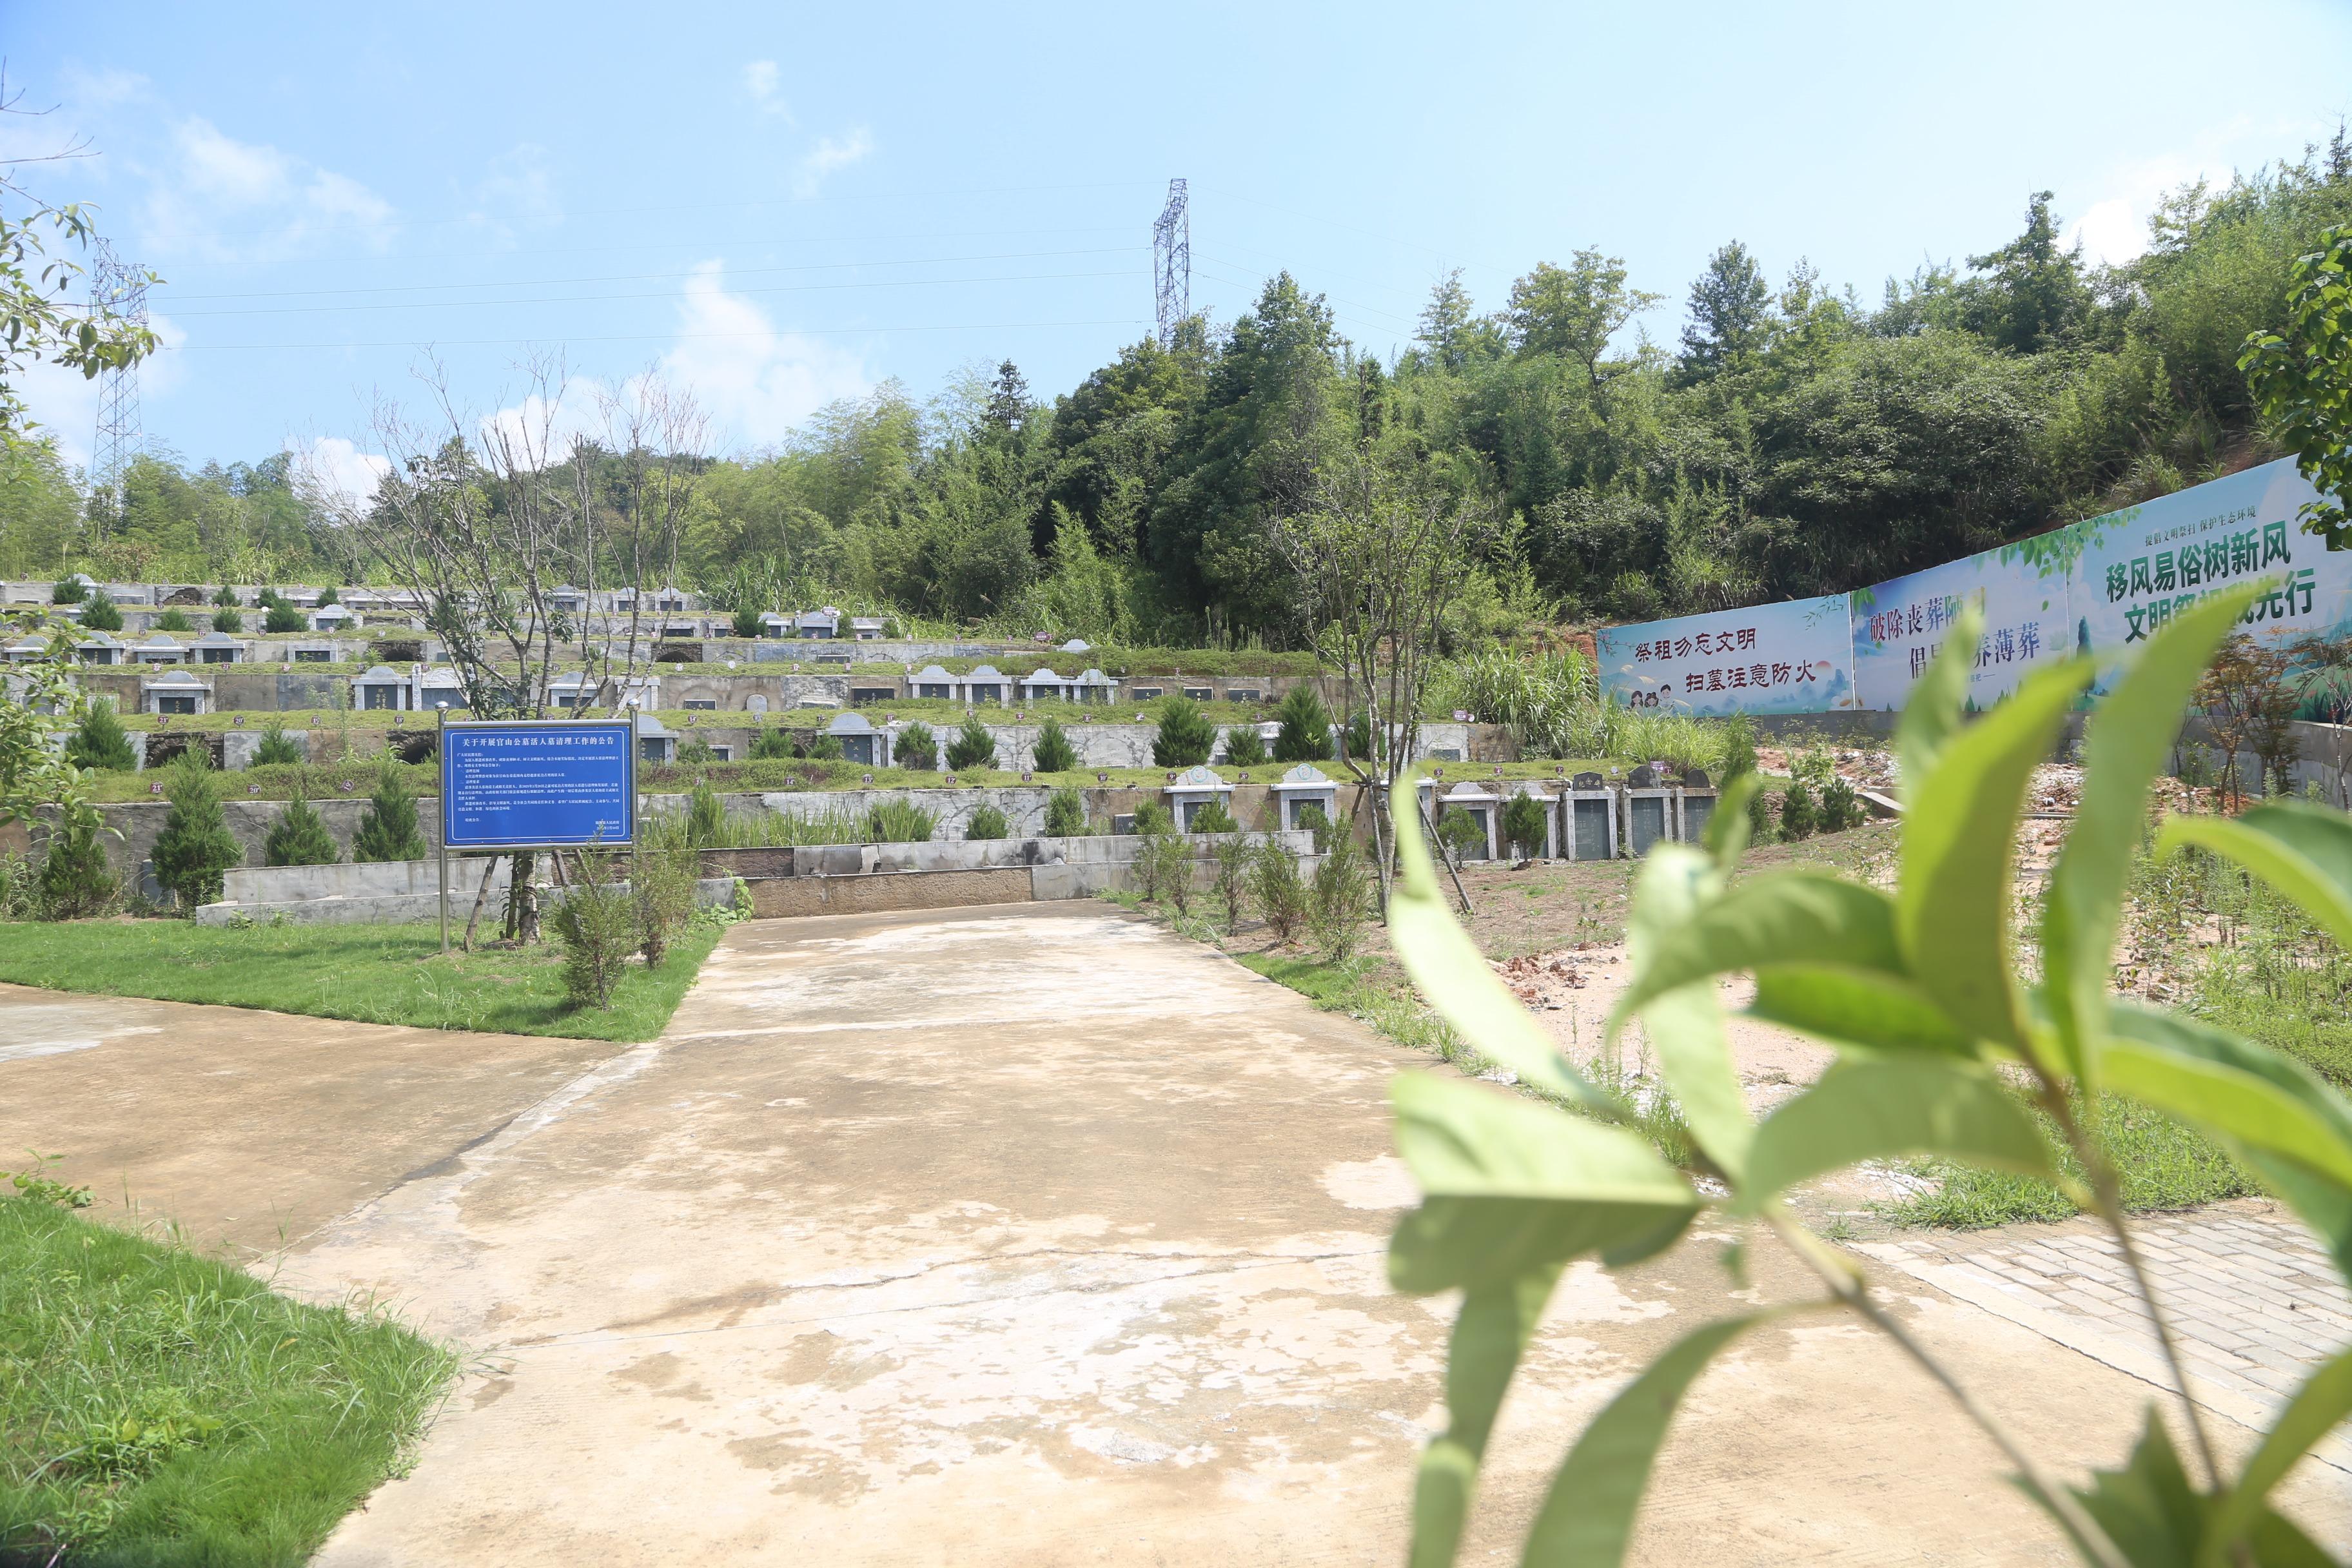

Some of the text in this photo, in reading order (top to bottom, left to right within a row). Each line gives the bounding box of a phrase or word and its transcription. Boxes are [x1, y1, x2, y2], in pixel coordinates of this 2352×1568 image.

[2145, 505, 2257, 547] 提倡文明祭扫 保护生态环境
[2106, 520, 2291, 603] 移风易俗树新风
[1634, 627, 1756, 663] 祭祖勿忘文明
[1909, 622, 2040, 680] 倡养薄葬
[1685, 660, 1817, 693] 扫墓注意防火
[462, 737, 614, 747] 关于开展官山公墓活人墓清理工作的公告
